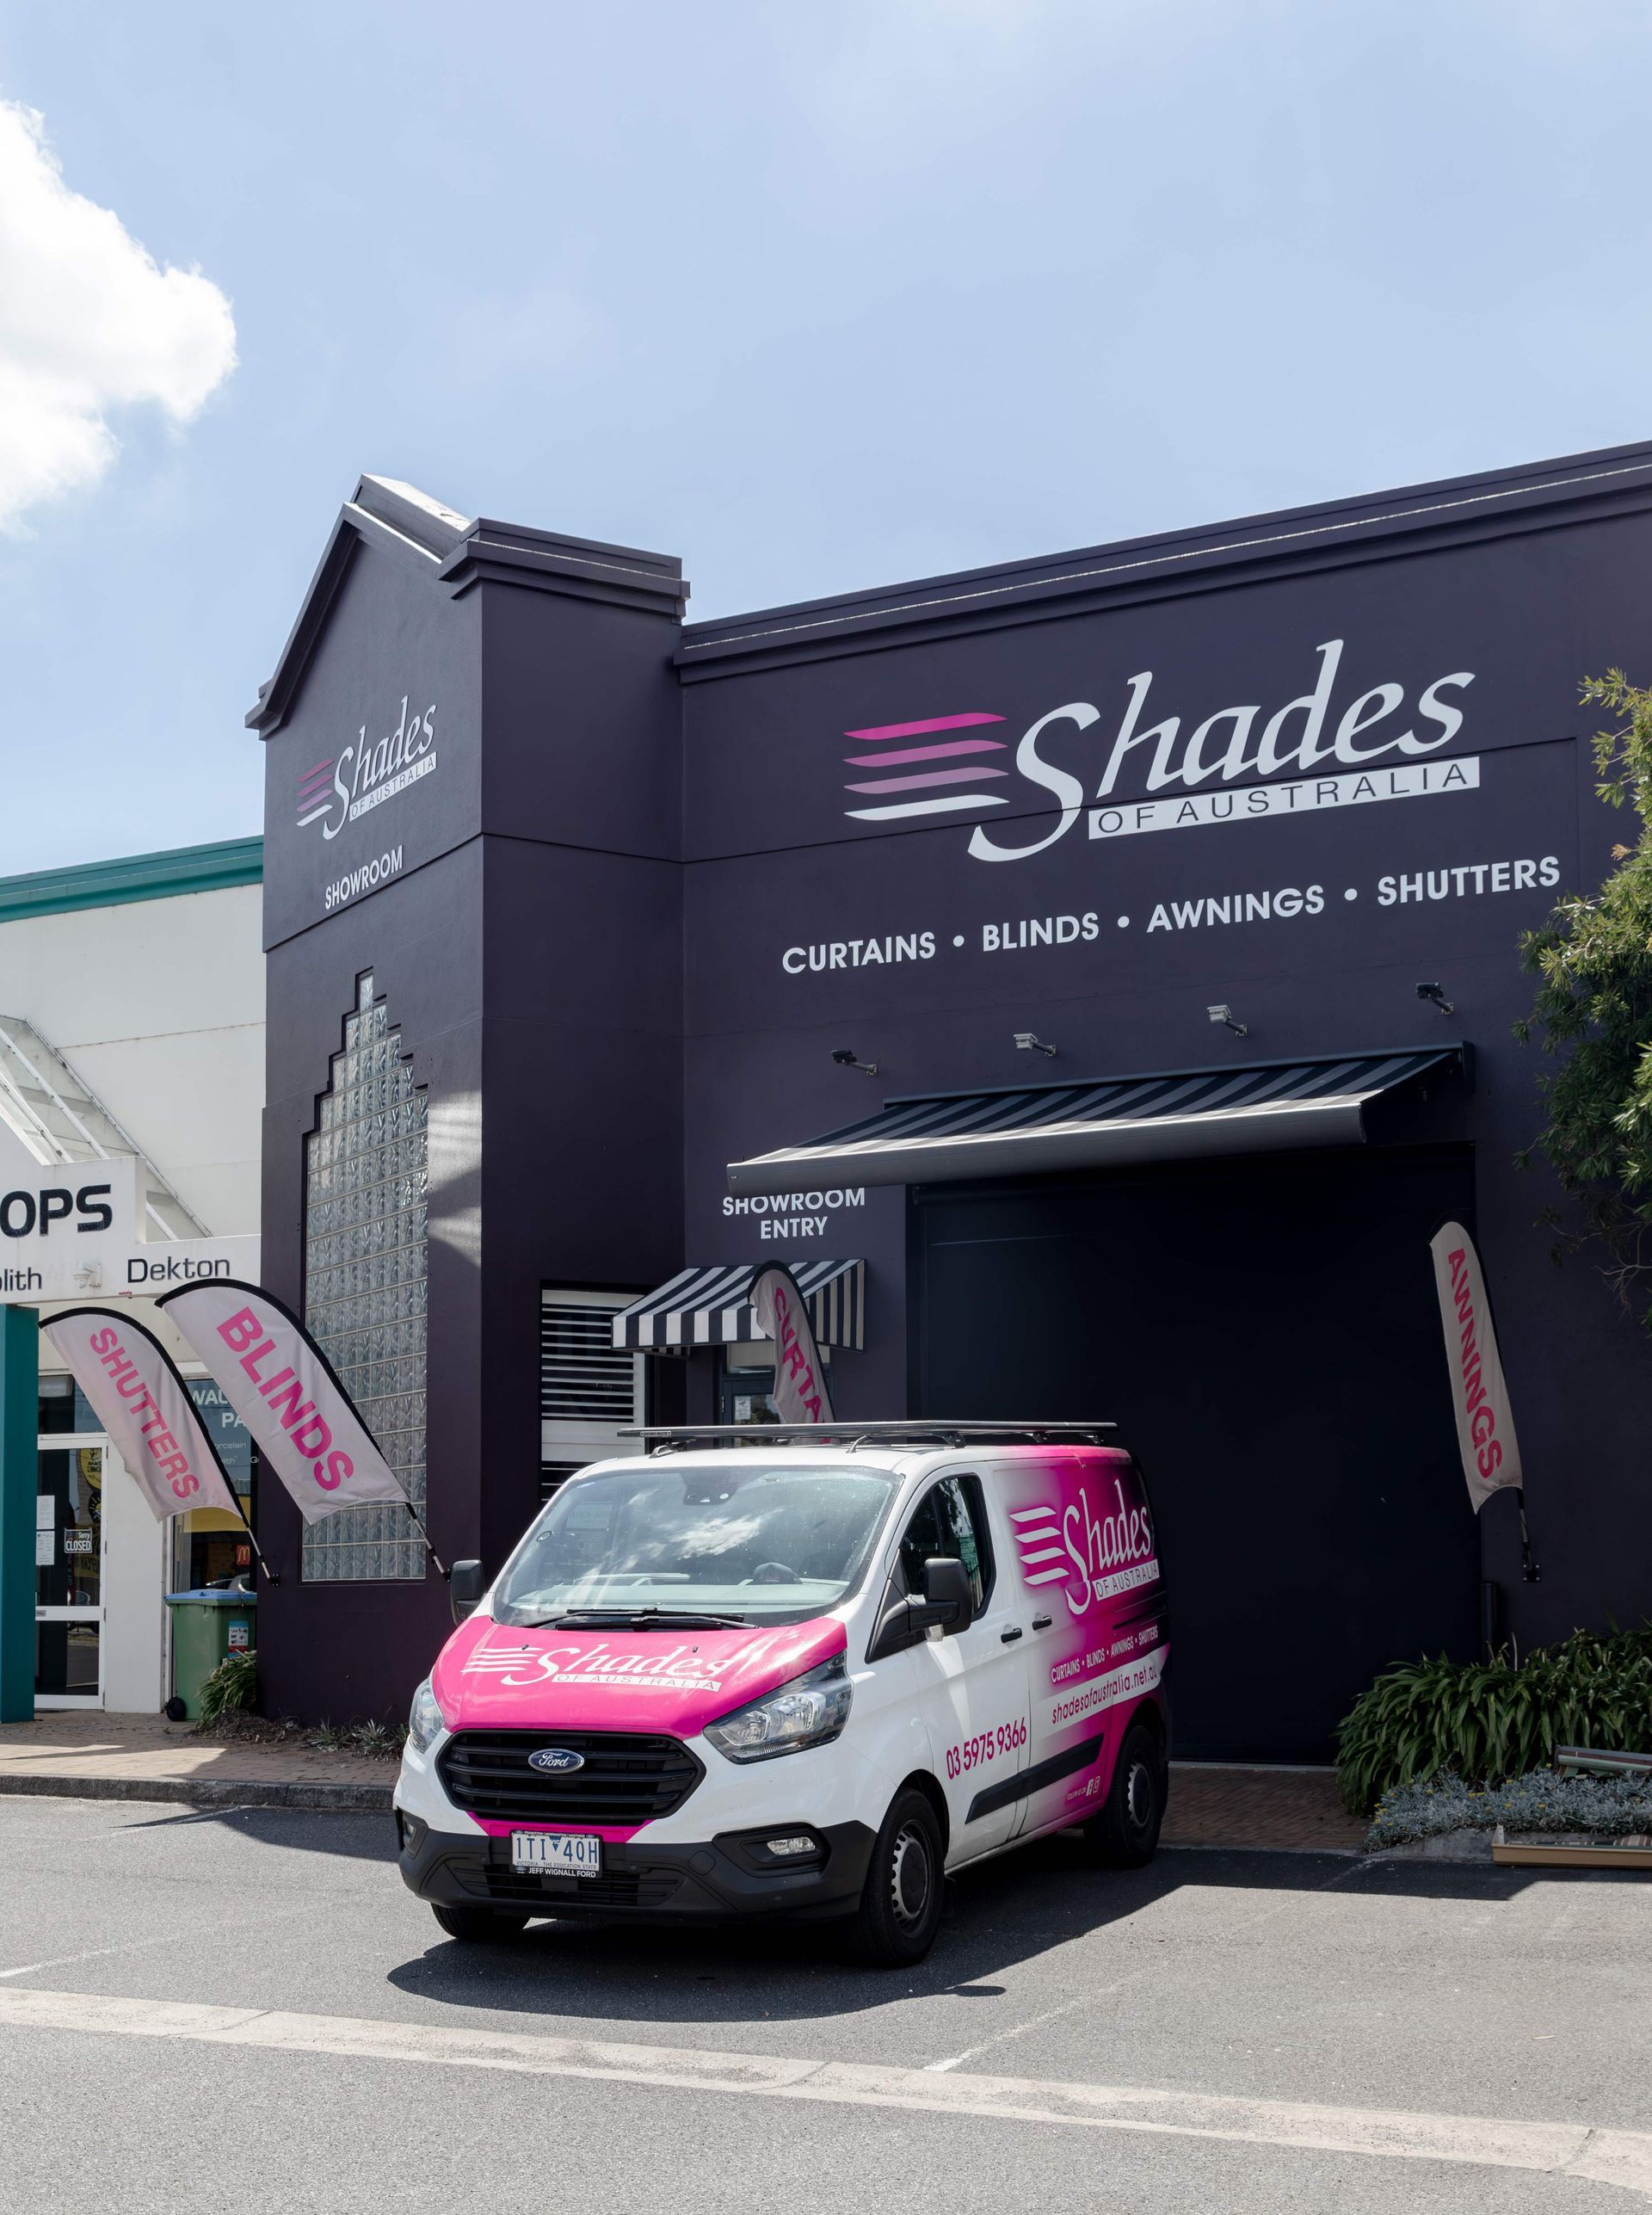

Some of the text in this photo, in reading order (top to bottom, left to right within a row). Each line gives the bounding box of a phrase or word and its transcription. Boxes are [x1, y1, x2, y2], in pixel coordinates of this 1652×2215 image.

[323, 694, 437, 840] Shades
[967, 639, 1476, 862] Shades
[351, 756, 435, 818] OF AUSTRALIA
[1096, 761, 1470, 835] OF AUSTRALIA
[325, 844, 404, 910] SHOWROOM
[782, 855, 1561, 976] CURTAINS BLINDS AWNINGS SHUTTERS
[722, 1187, 866, 1217] SHOWROOM
[760, 1216, 828, 1239] ENTRY
[127, 1256, 231, 1283] Dekton
[775, 1287, 829, 1425] CURTA
[1448, 1248, 1502, 1479] AWNINGS
[89, 1328, 200, 1498] SHUTTERS
[216, 1306, 354, 1491] BLINDS
[65, 1540, 91, 1552] CLOSED
[77, 1532, 90, 1540] Sorry
[1063, 1479, 1151, 1615] Shades
[1095, 1561, 1158, 1598] OF AUSTRALIA
[501, 1644, 730, 1685] Shades
[557, 1675, 716, 1691] OF AUSTRALIA
[1051, 1625, 1159, 1683] CURTAINS BLINDS AWNINGS SHUTTERS
[1052, 1664, 1157, 1724] shadesofaustralia.net.au
[538, 1751, 570, 1768] Ford
[946, 1717, 1026, 1780] 03 5975 9366
[544, 1868, 576, 1877] WIGNALL
